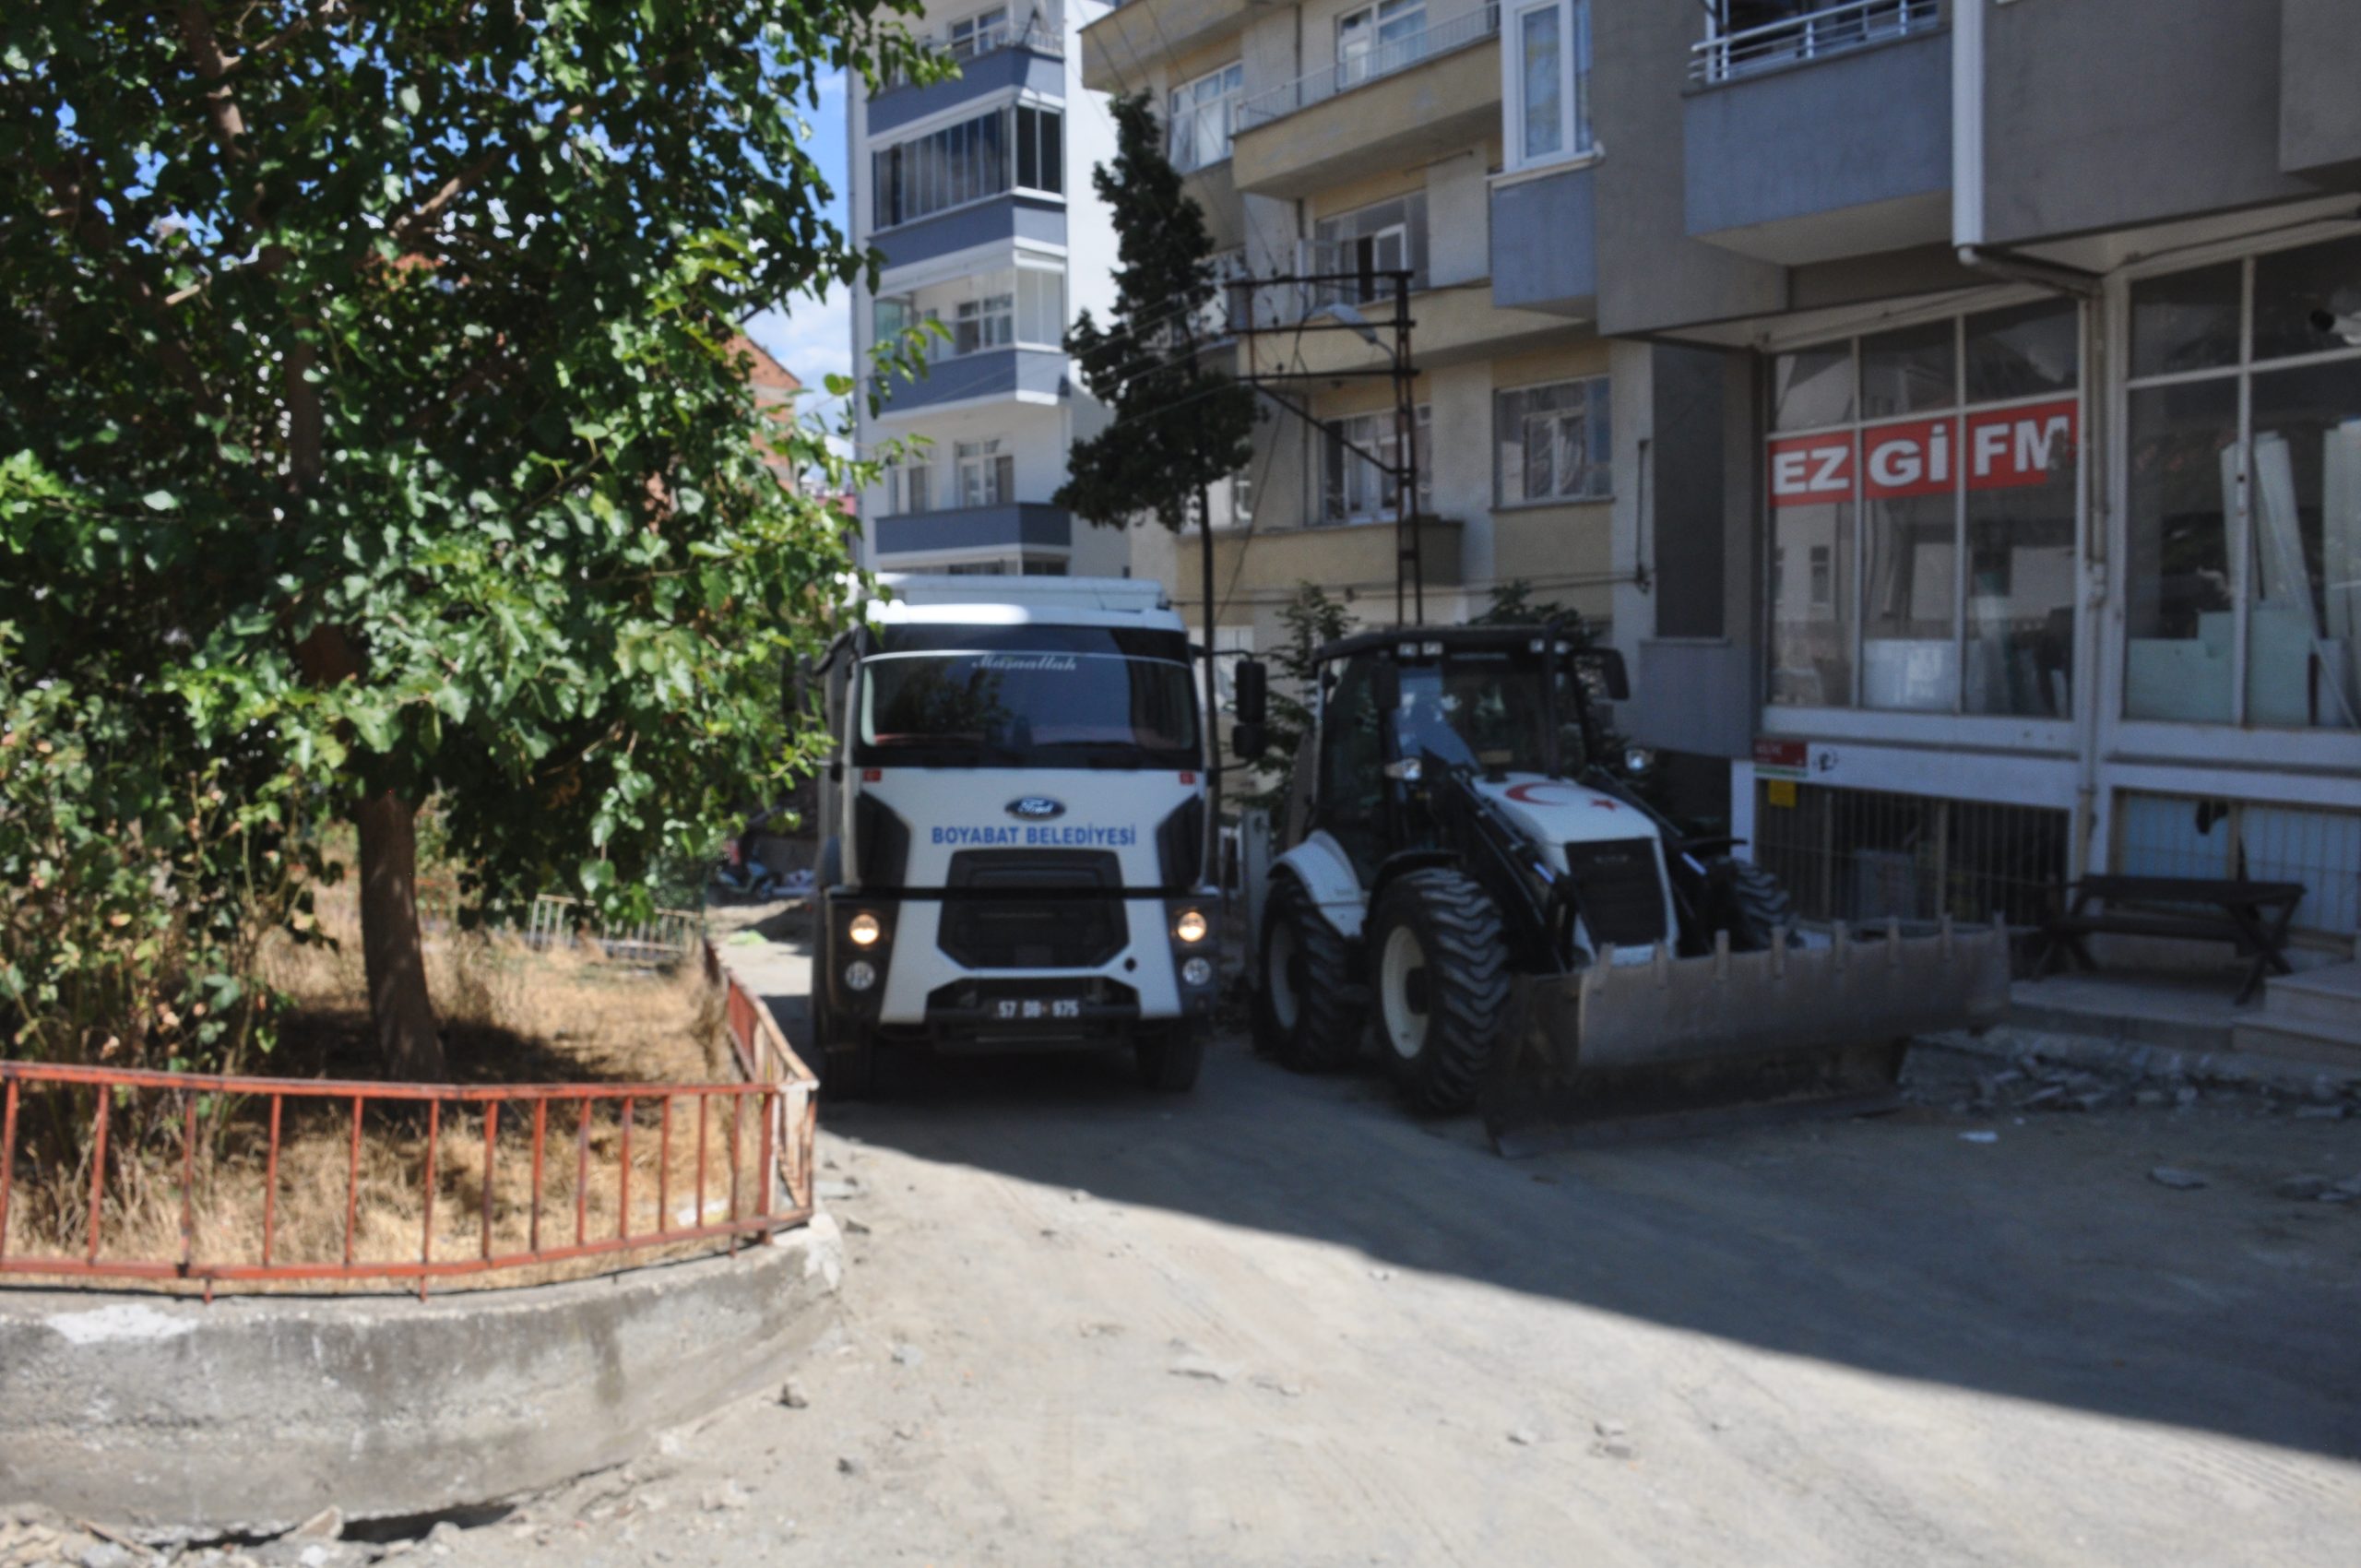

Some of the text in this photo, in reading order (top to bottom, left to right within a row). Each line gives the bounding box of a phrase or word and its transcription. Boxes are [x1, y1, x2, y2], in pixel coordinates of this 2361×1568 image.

[1772, 423, 1949, 496] EZGİ
[1018, 797, 1054, 814] Ford
[931, 823, 1136, 845] BOYABAT BELEDİYESİ
